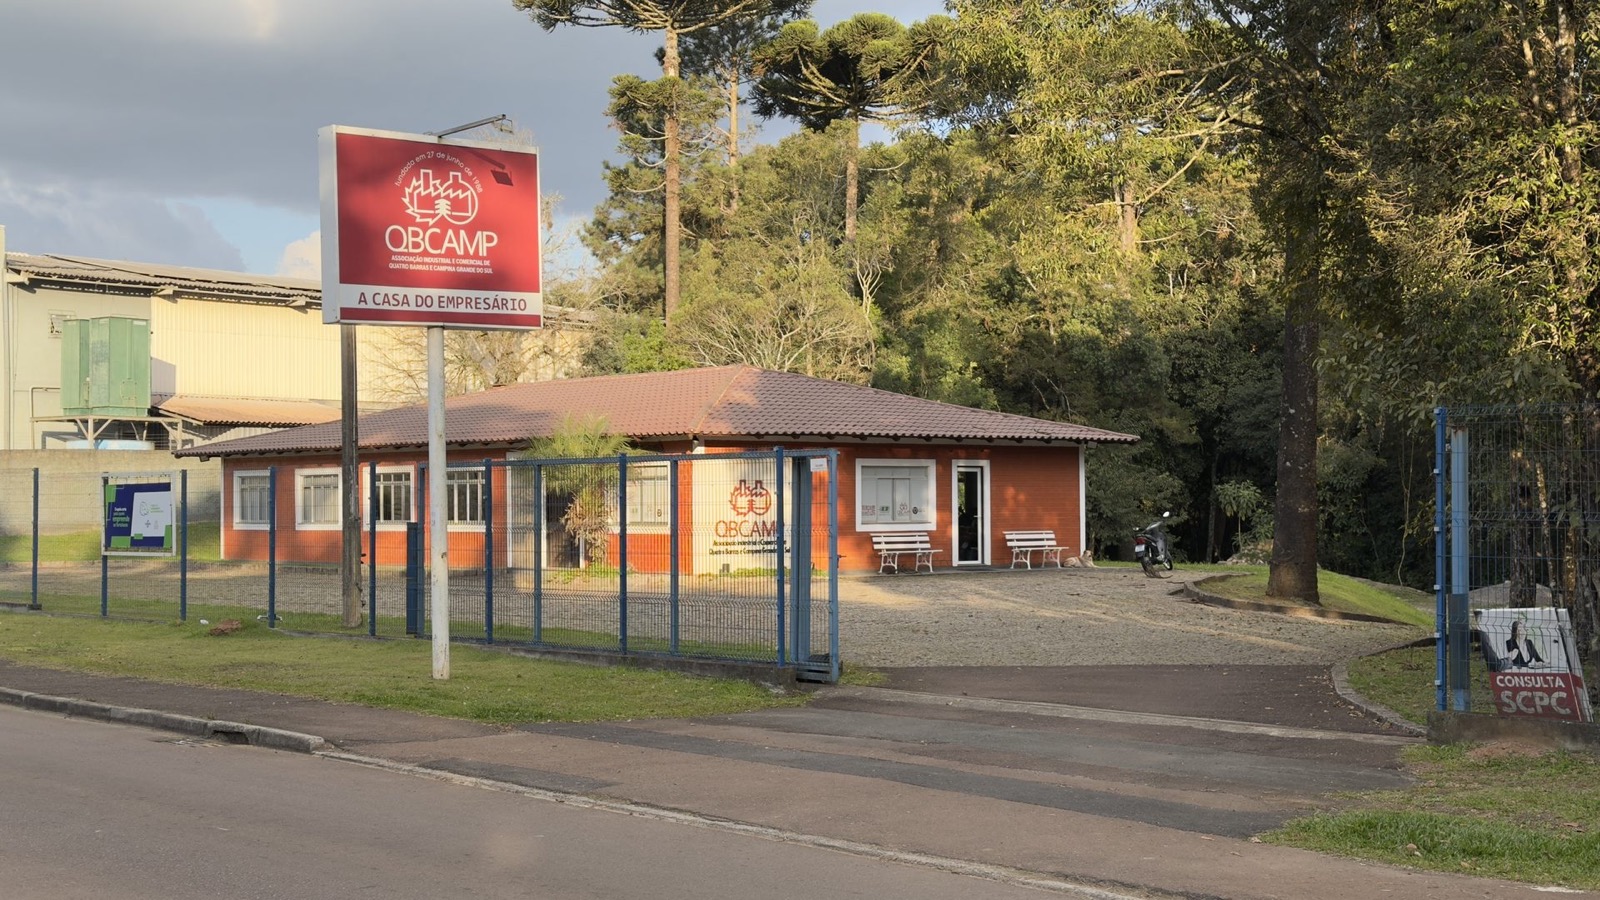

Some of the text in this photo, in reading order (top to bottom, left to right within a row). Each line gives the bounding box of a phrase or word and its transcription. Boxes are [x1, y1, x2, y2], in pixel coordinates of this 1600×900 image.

[416, 154, 426, 162] em
[446, 154, 464, 168] junho
[464, 166, 473, 176] de
[385, 225, 498, 256] QBCAMP
[391, 255, 422, 263] ASSOCIAÇÃO
[456, 258, 483, 266] COMERCIAL
[358, 292, 527, 311] A CASA DO EMPRESÁRIO
[715, 520, 779, 537] QBCAM
[1496, 676, 1565, 688] CONSULTA
[1500, 691, 1571, 714] SCPC
